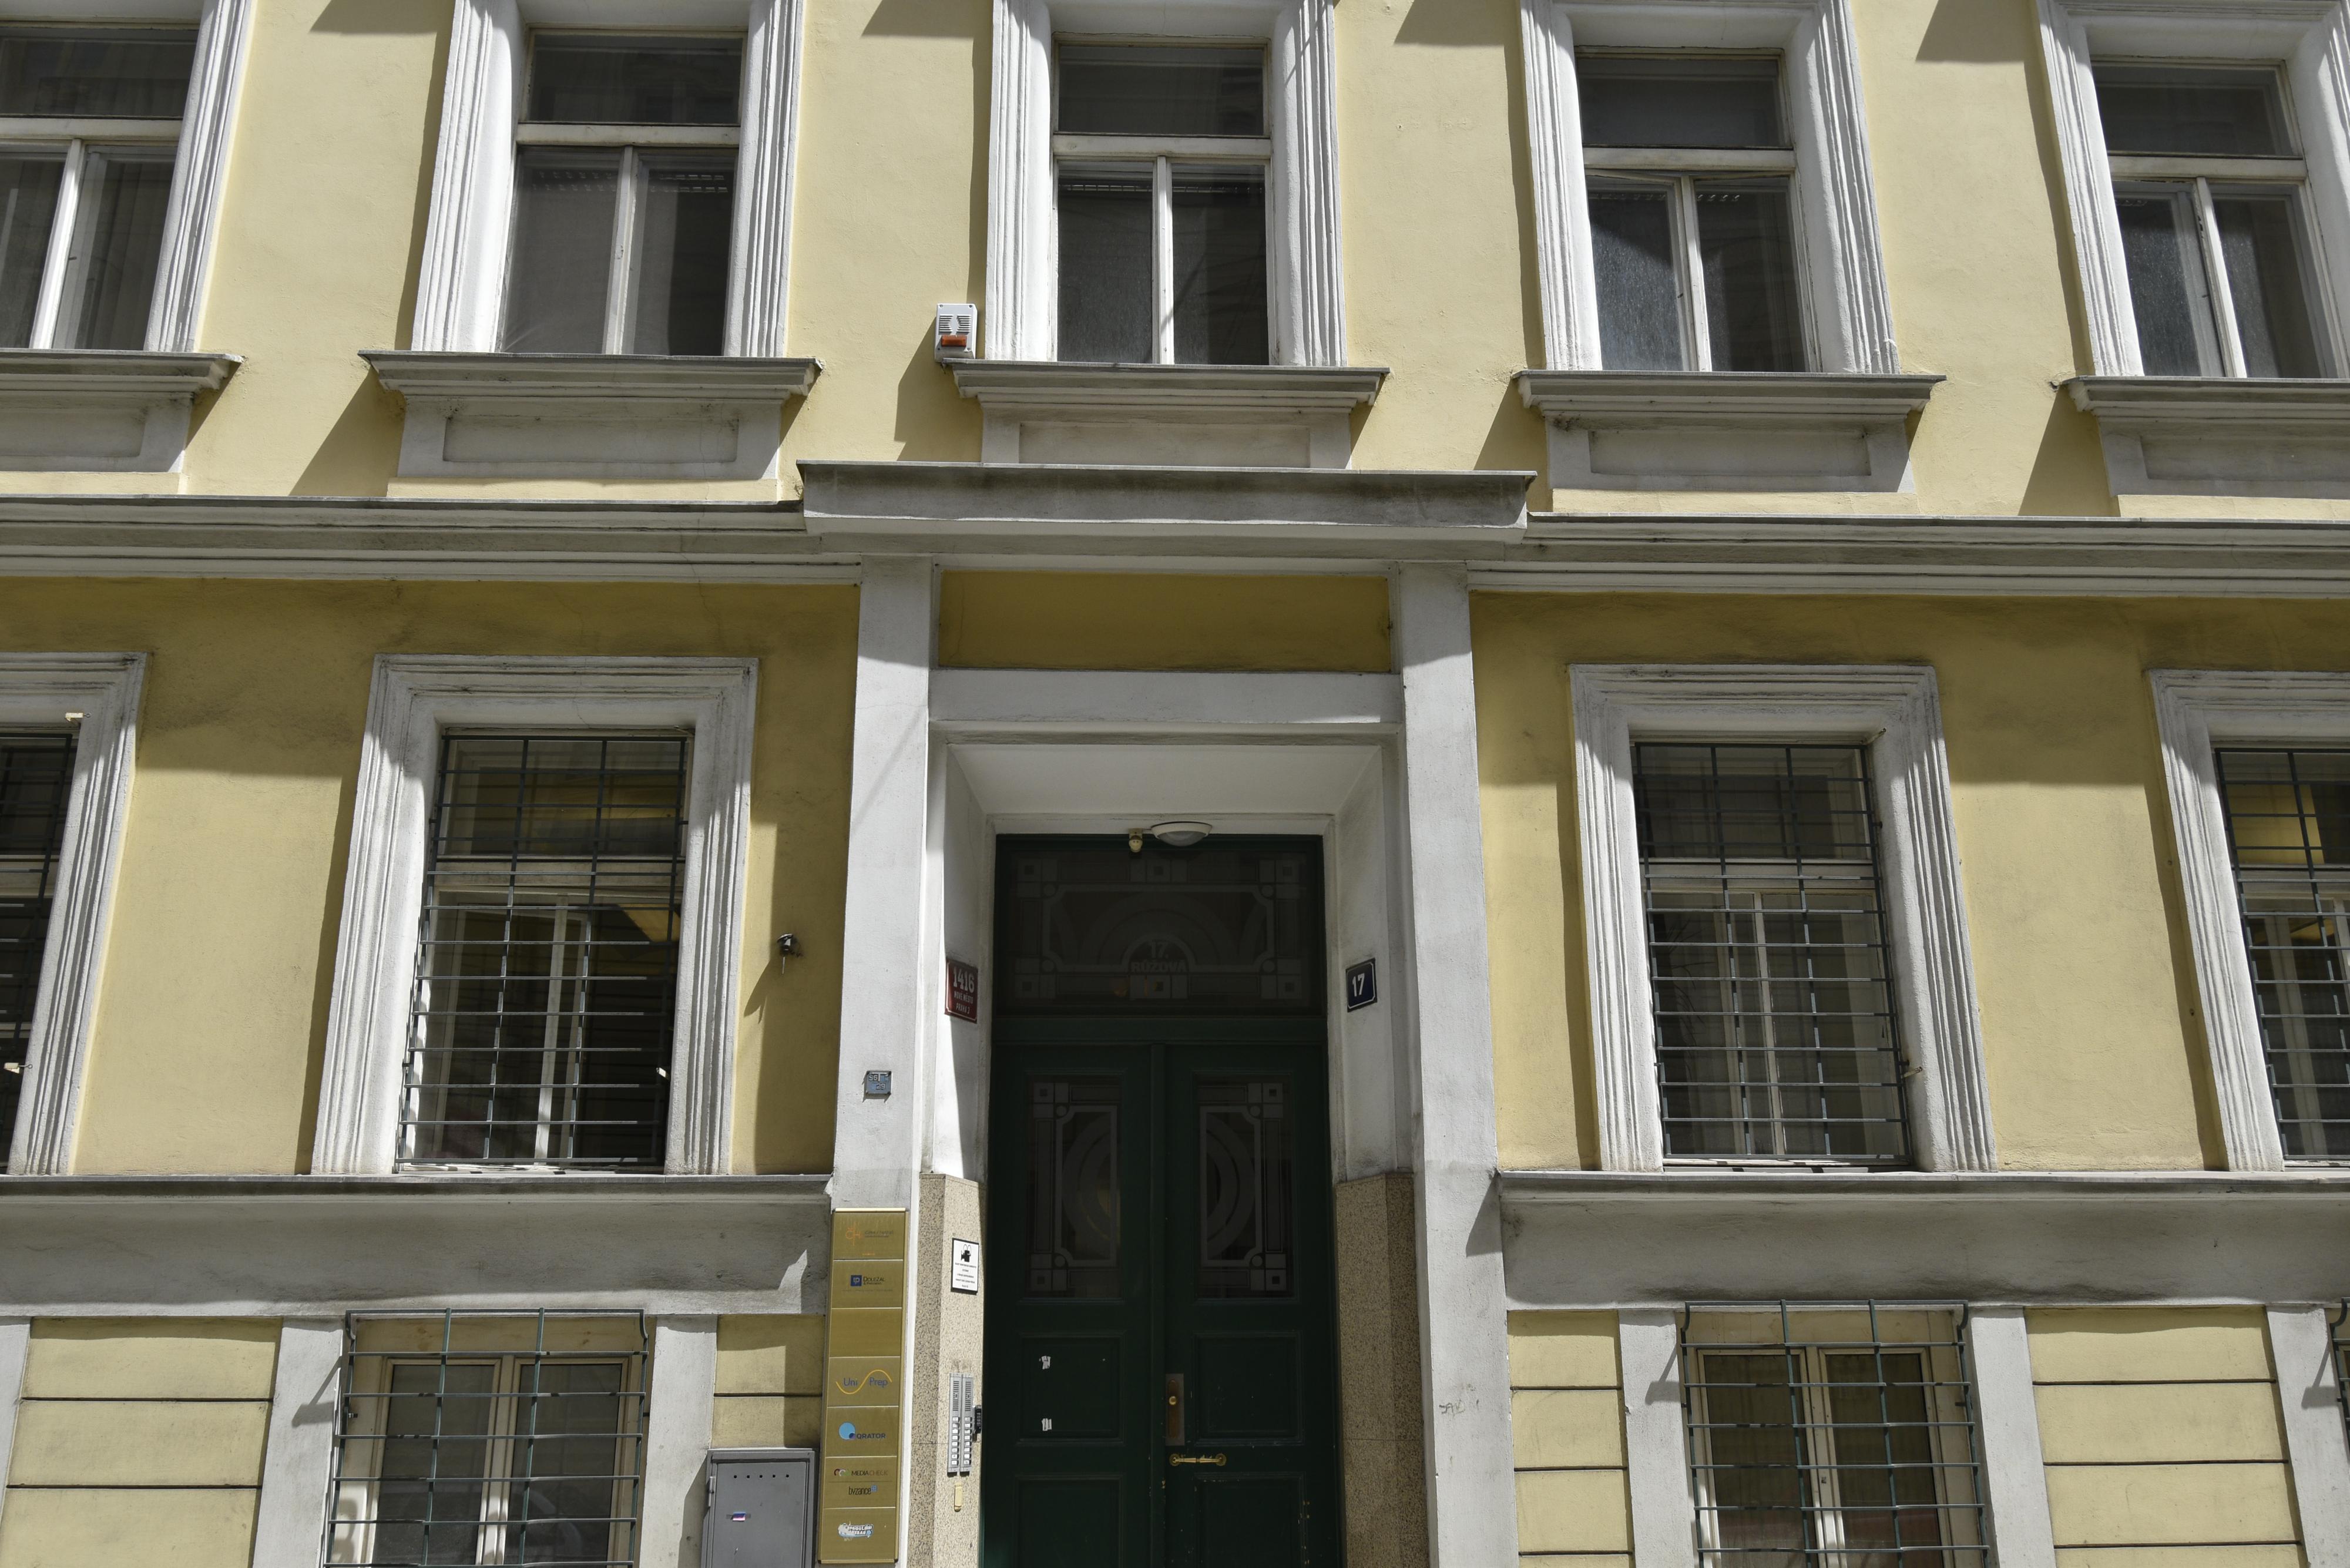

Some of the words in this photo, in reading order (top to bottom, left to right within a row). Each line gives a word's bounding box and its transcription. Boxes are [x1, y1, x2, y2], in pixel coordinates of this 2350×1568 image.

[954, 966, 975, 993] 1416
[1352, 973, 1365, 997] 17
[844, 1377, 858, 1386] Uni
[870, 1377, 888, 1388] Prep
